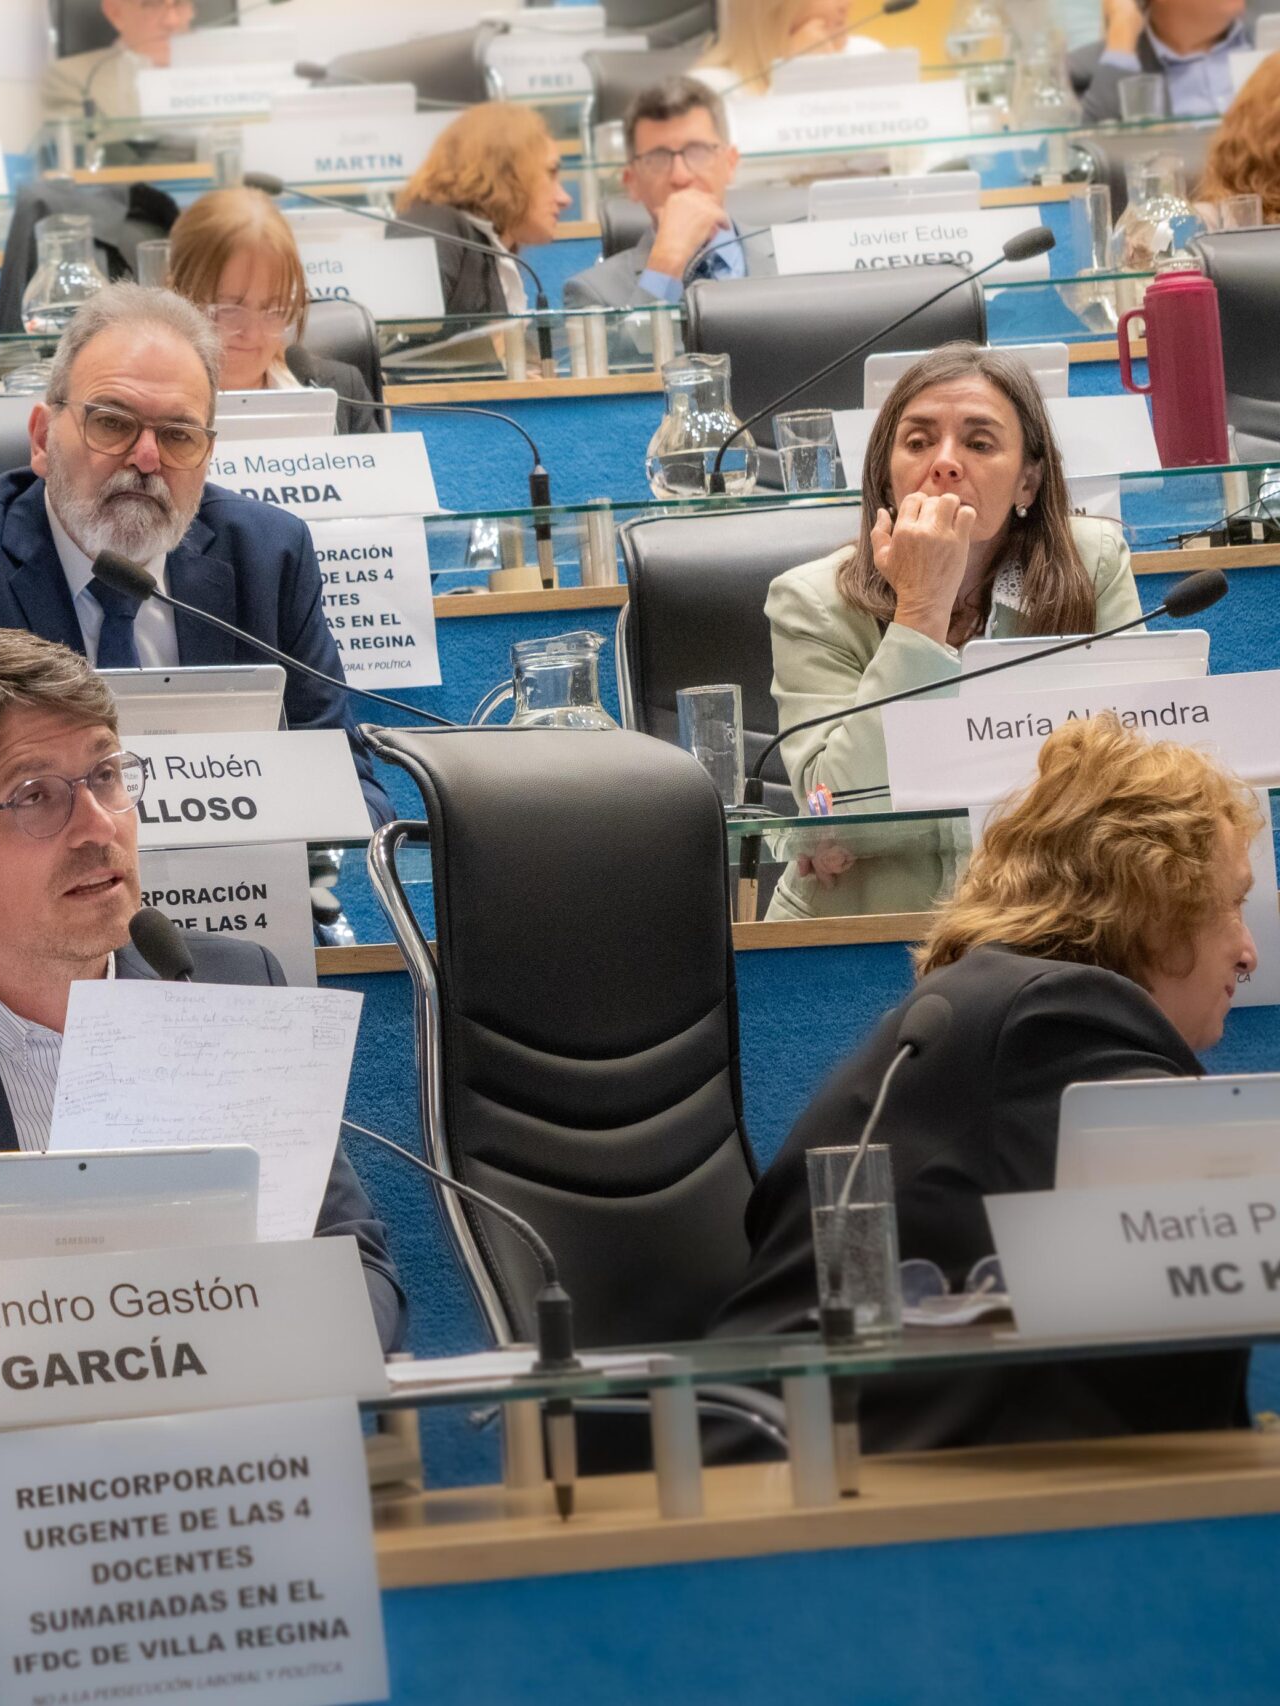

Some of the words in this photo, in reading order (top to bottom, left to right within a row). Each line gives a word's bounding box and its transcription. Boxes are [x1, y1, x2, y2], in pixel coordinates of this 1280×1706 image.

[315, 153, 403, 172] MARTIN
[848, 230, 910, 248] Javier
[915, 224, 970, 241] Edue
[305, 260, 344, 275] erta
[207, 458, 238, 476] ría
[244, 452, 376, 477] Magdalena
[240, 484, 342, 505] DARDA
[345, 570, 379, 583] LAS
[383, 568, 395, 581] 4
[352, 614, 374, 628] EN
[380, 613, 402, 626] EL
[350, 635, 416, 651] REGINA
[343, 662, 366, 672] ORAL
[374, 659, 412, 672] POLÍTICA
[966, 713, 1053, 743] María
[165, 754, 263, 781] Rubén
[138, 796, 257, 824] LLOSO
[140, 882, 267, 907] RPORACIÓN
[206, 915, 247, 933] LAS
[254, 913, 268, 929] 4
[1166, 1261, 1245, 1298] MC
[108, 1276, 260, 1319] Gastón
[1, 1336, 208, 1391] GARCÍA
[16, 1454, 310, 1509] REINCORPORACIÓN
[24, 1515, 170, 1551] URGENTE
[180, 1508, 218, 1534] DE
[229, 1501, 285, 1528] LAS
[294, 1497, 312, 1520] 4
[91, 1546, 254, 1585] DOCENTES
[30, 1590, 228, 1636] SUMARIADAS
[238, 1584, 279, 1610] EN
[288, 1580, 325, 1603] EL
[13, 1649, 81, 1675] IFDC
[92, 1643, 130, 1667] DE
[139, 1635, 227, 1661] VILLA
[235, 1618, 350, 1650] REGINA
